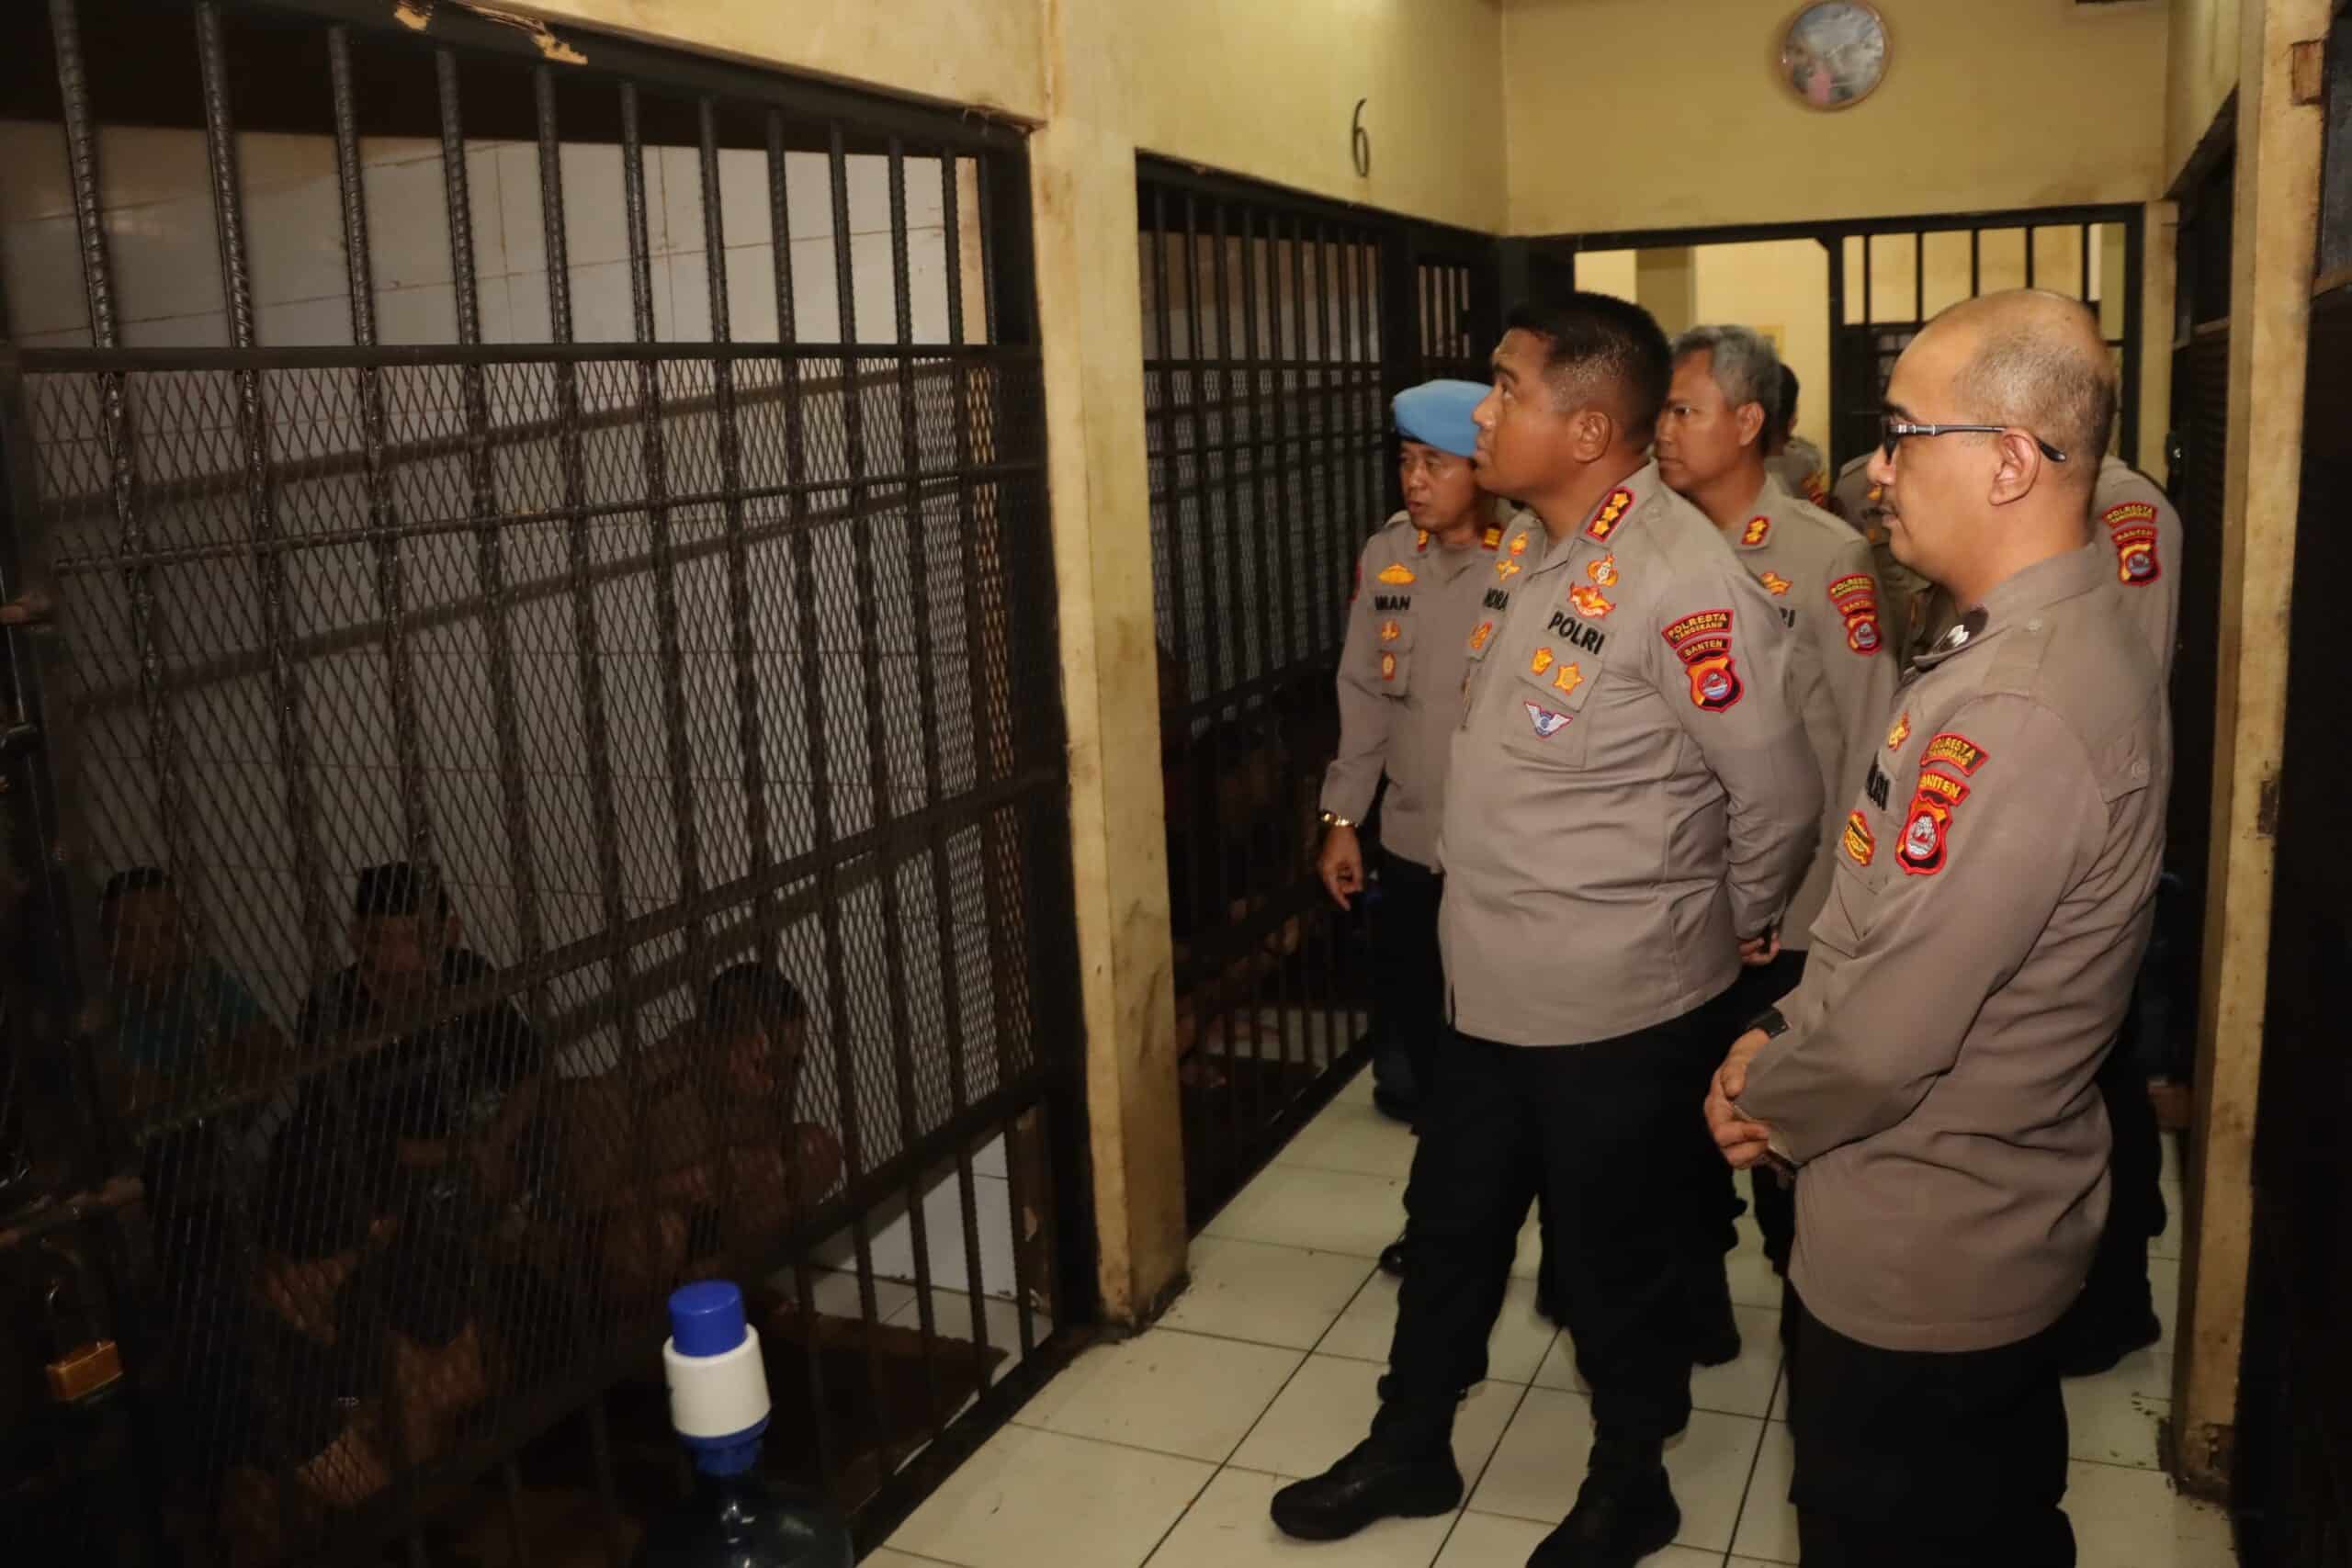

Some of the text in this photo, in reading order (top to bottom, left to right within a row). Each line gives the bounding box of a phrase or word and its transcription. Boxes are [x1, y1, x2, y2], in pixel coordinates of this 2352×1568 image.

[1352, 98, 1370, 178] 6
[1548, 610, 1605, 655] POLRI
[1668, 613, 1727, 637] POLRESTA
[1684, 639, 1723, 657] BANTEN
